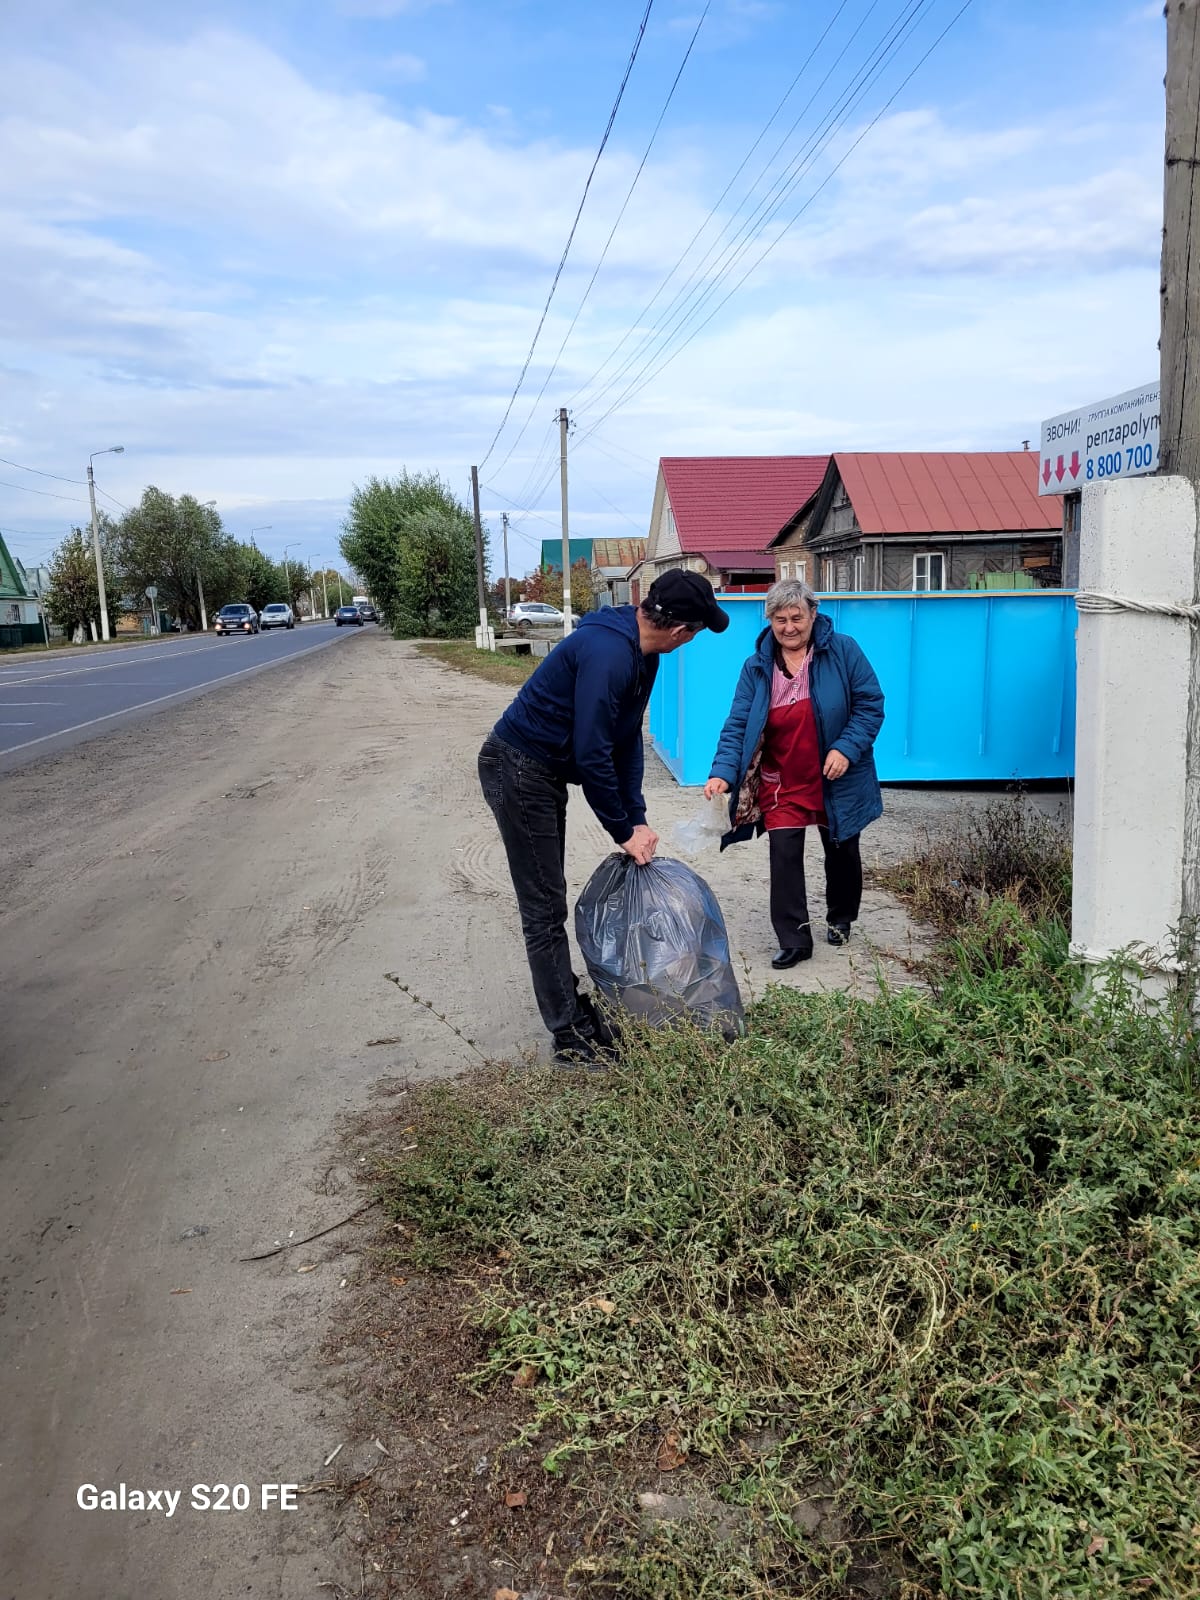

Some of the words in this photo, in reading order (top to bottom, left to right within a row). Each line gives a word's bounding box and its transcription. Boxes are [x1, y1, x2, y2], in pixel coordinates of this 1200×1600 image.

[1088, 408, 1110, 423] ГРУППА
[1110, 394, 1144, 416] КОМПАНИЙ
[1046, 418, 1081, 443] ЗВОНИ!
[1086, 458, 1094, 480] 8
[1097, 451, 1122, 477] 800
[1126, 443, 1152, 471] 700
